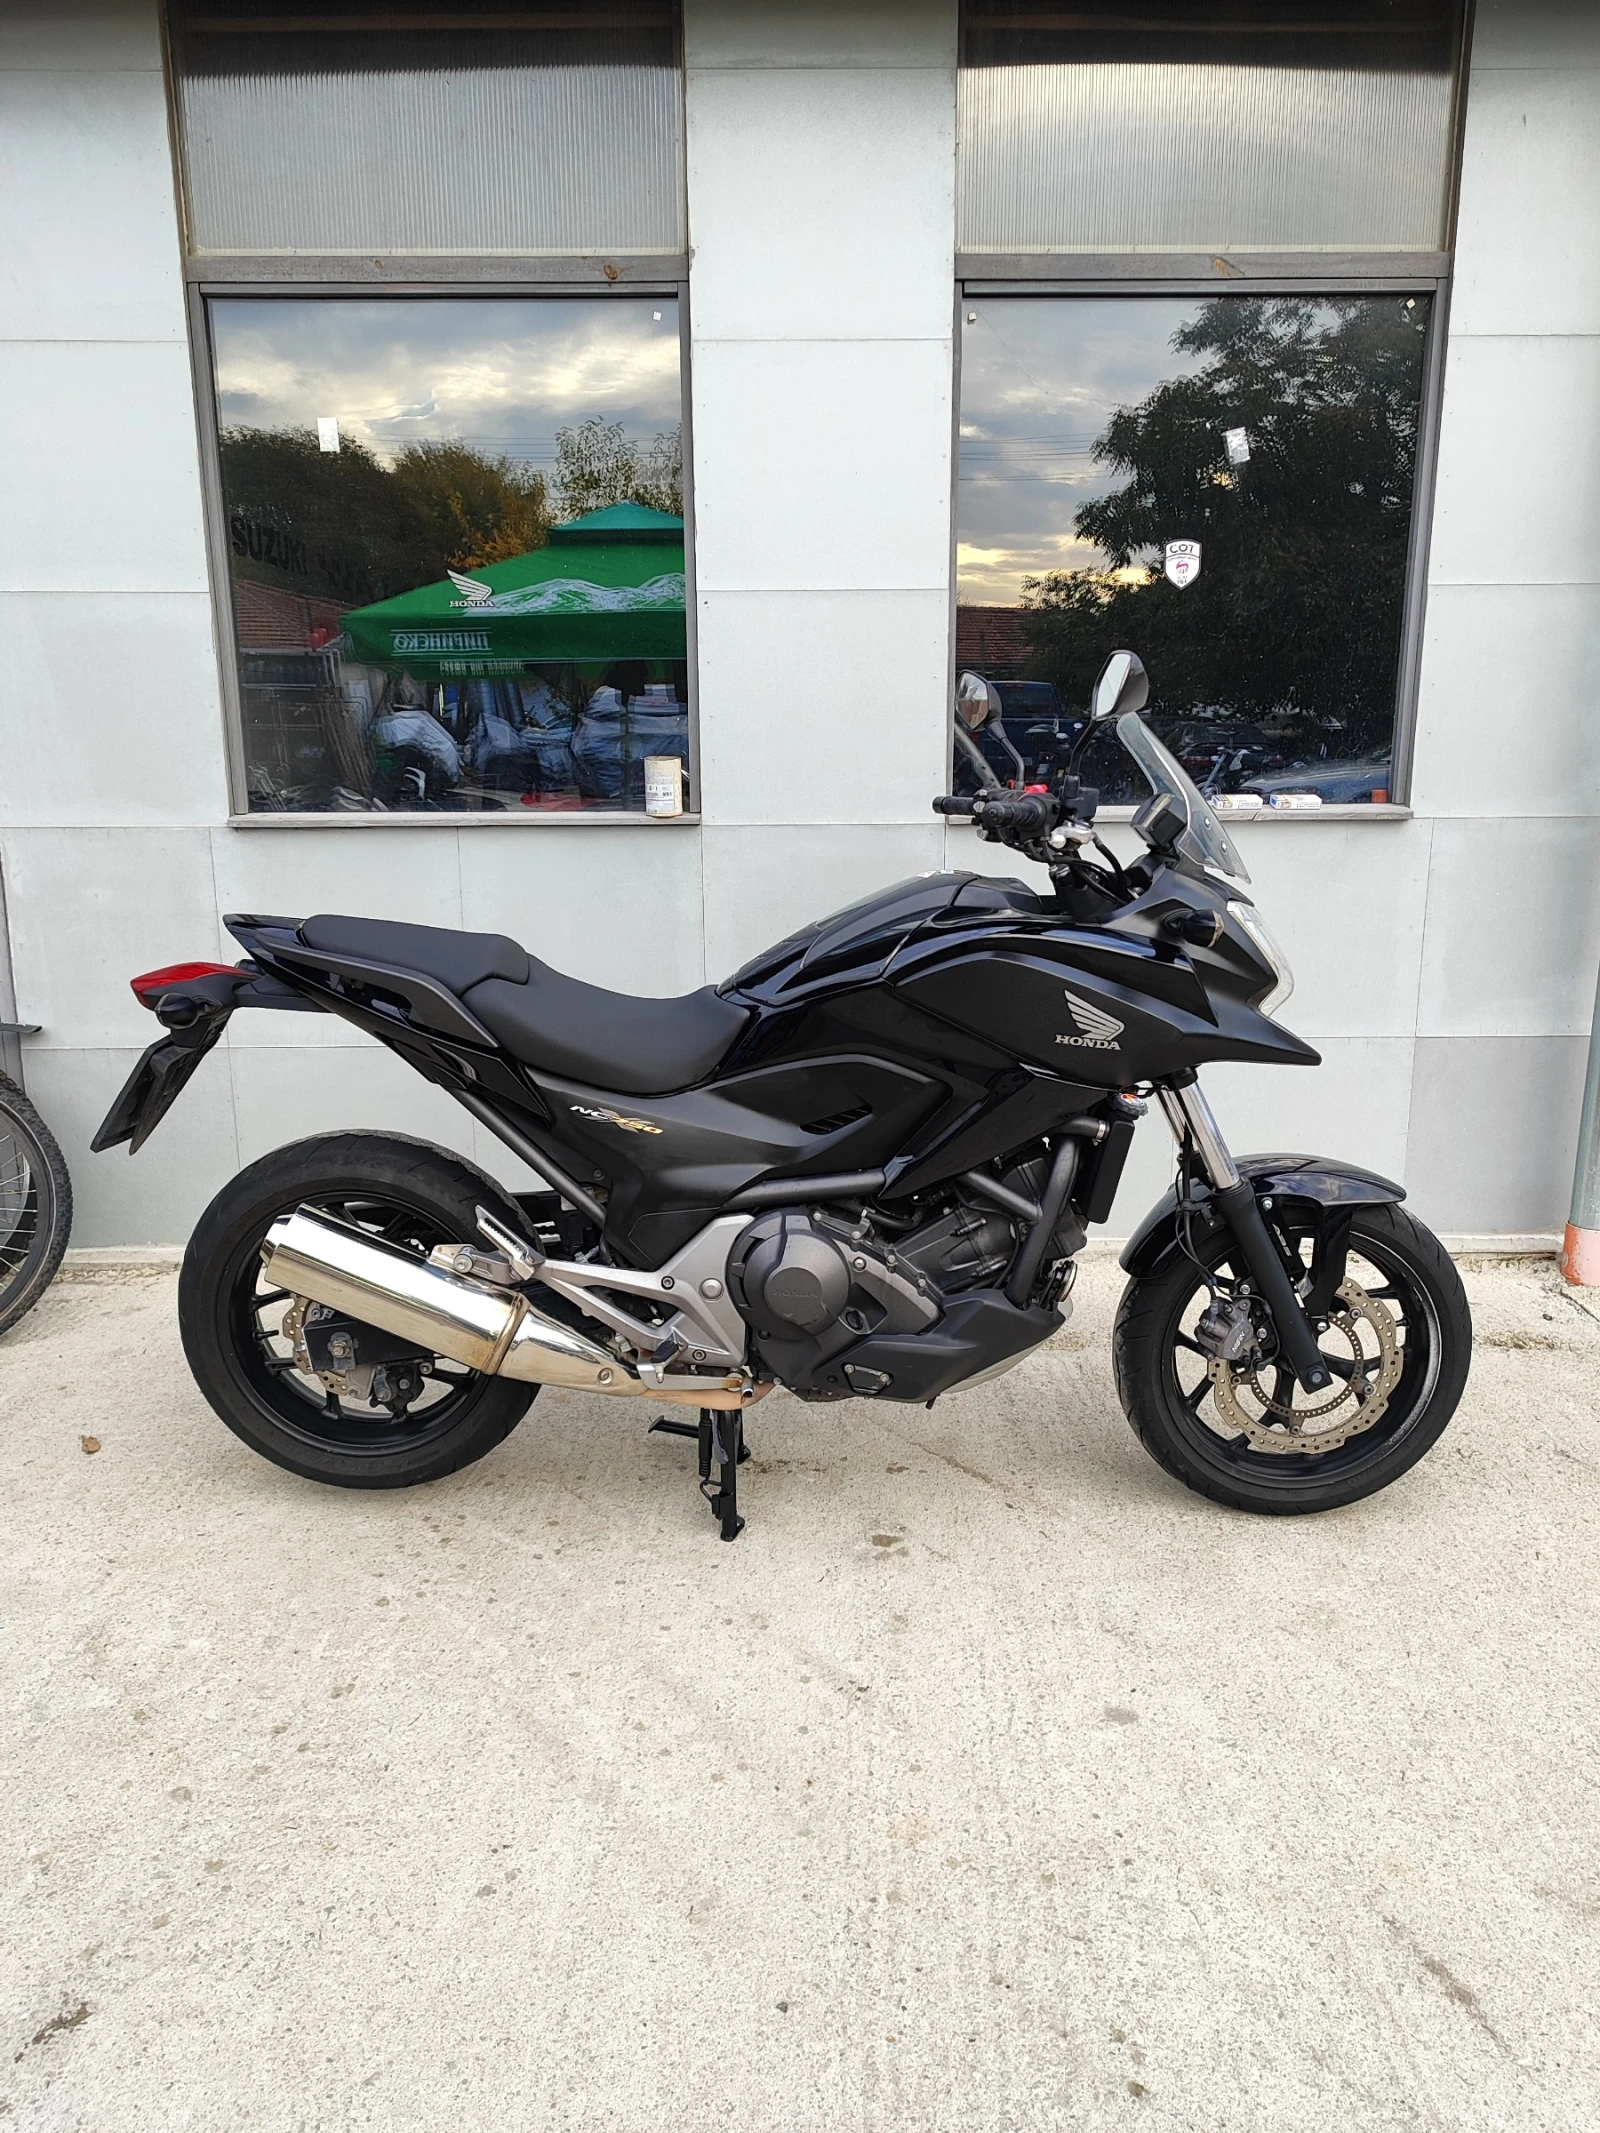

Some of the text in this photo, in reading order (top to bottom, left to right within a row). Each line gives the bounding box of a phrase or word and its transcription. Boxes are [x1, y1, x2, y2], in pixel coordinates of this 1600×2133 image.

[231, 516, 307, 576] SUZUKI
[449, 600, 494, 608] HONDA
[1054, 1034, 1121, 1051] HONDA
[772, 1288, 819, 1298] HONDA
